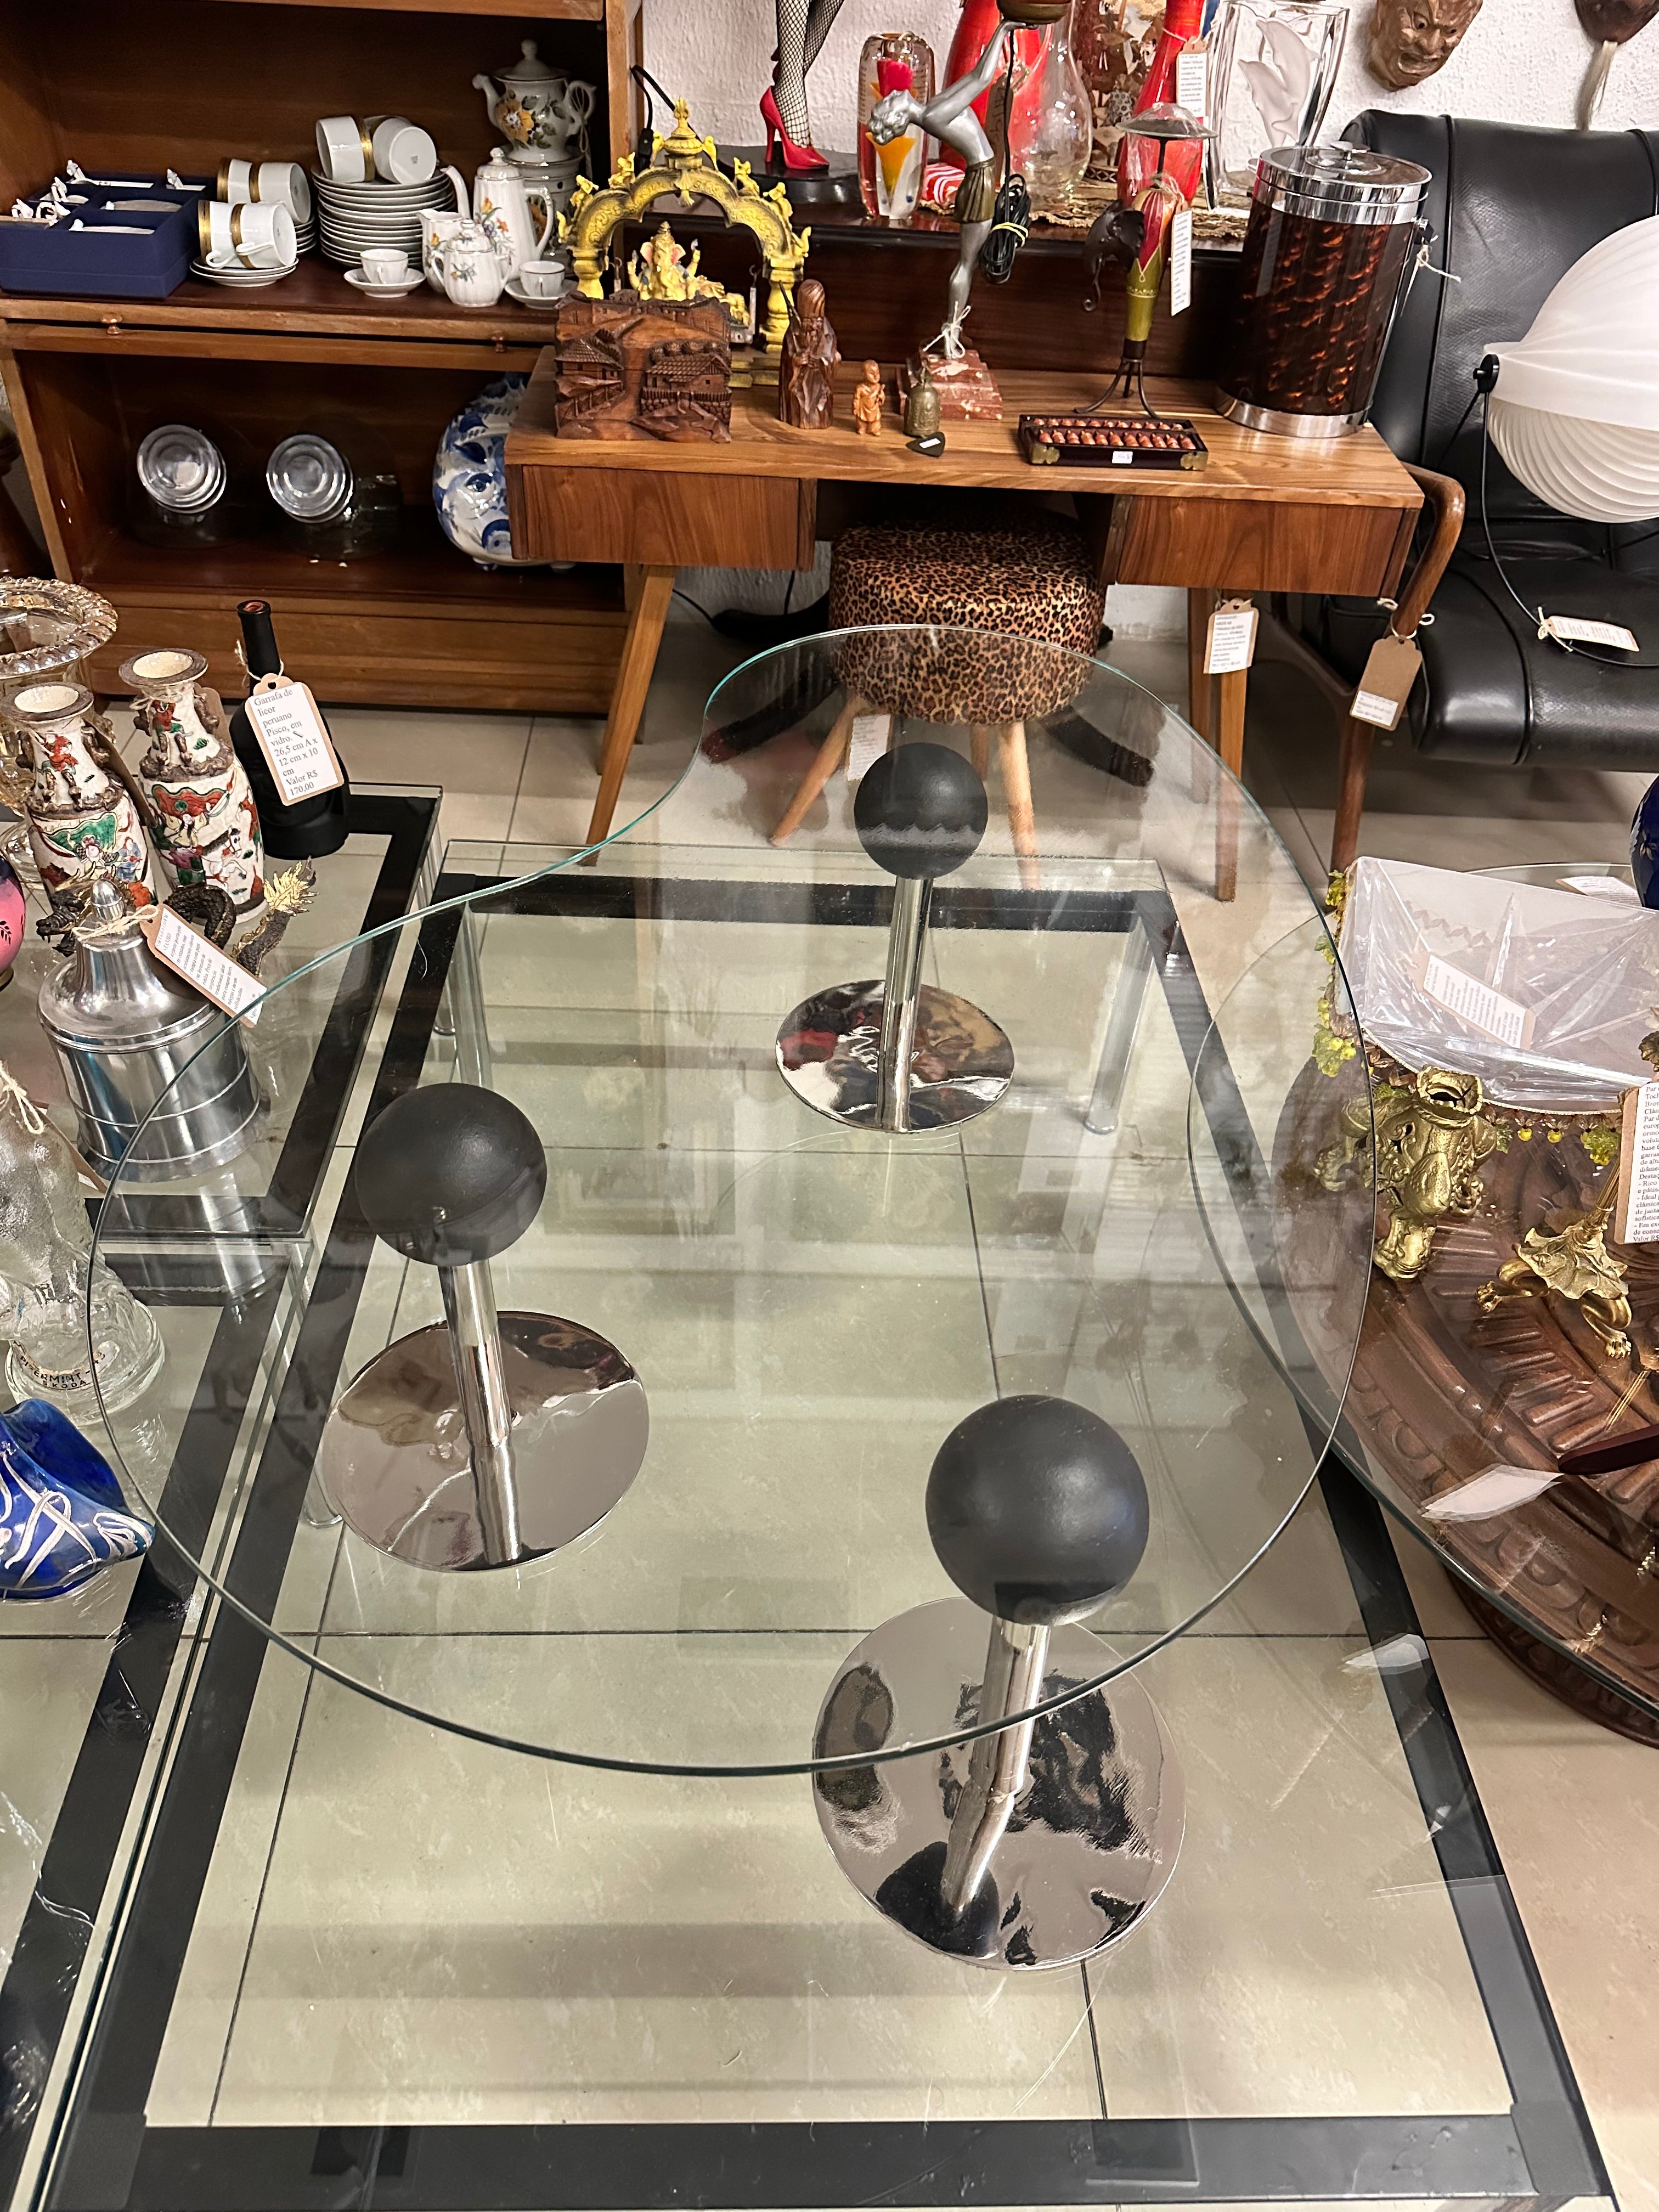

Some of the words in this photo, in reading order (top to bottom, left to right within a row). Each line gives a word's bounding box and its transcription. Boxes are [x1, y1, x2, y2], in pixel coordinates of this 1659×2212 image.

[254, 691, 283, 706] Garrafa
[257, 707, 275, 716] licor
[263, 713, 292, 729] peruano
[266, 726, 290, 737] Pisco,
[274, 746, 291, 757] 26,5
[279, 758, 289, 766] 12
[309, 748, 318, 756] 10
[286, 775, 305, 786] Valor
[307, 769, 318, 779] R$
[290, 782, 314, 795] 170,00
